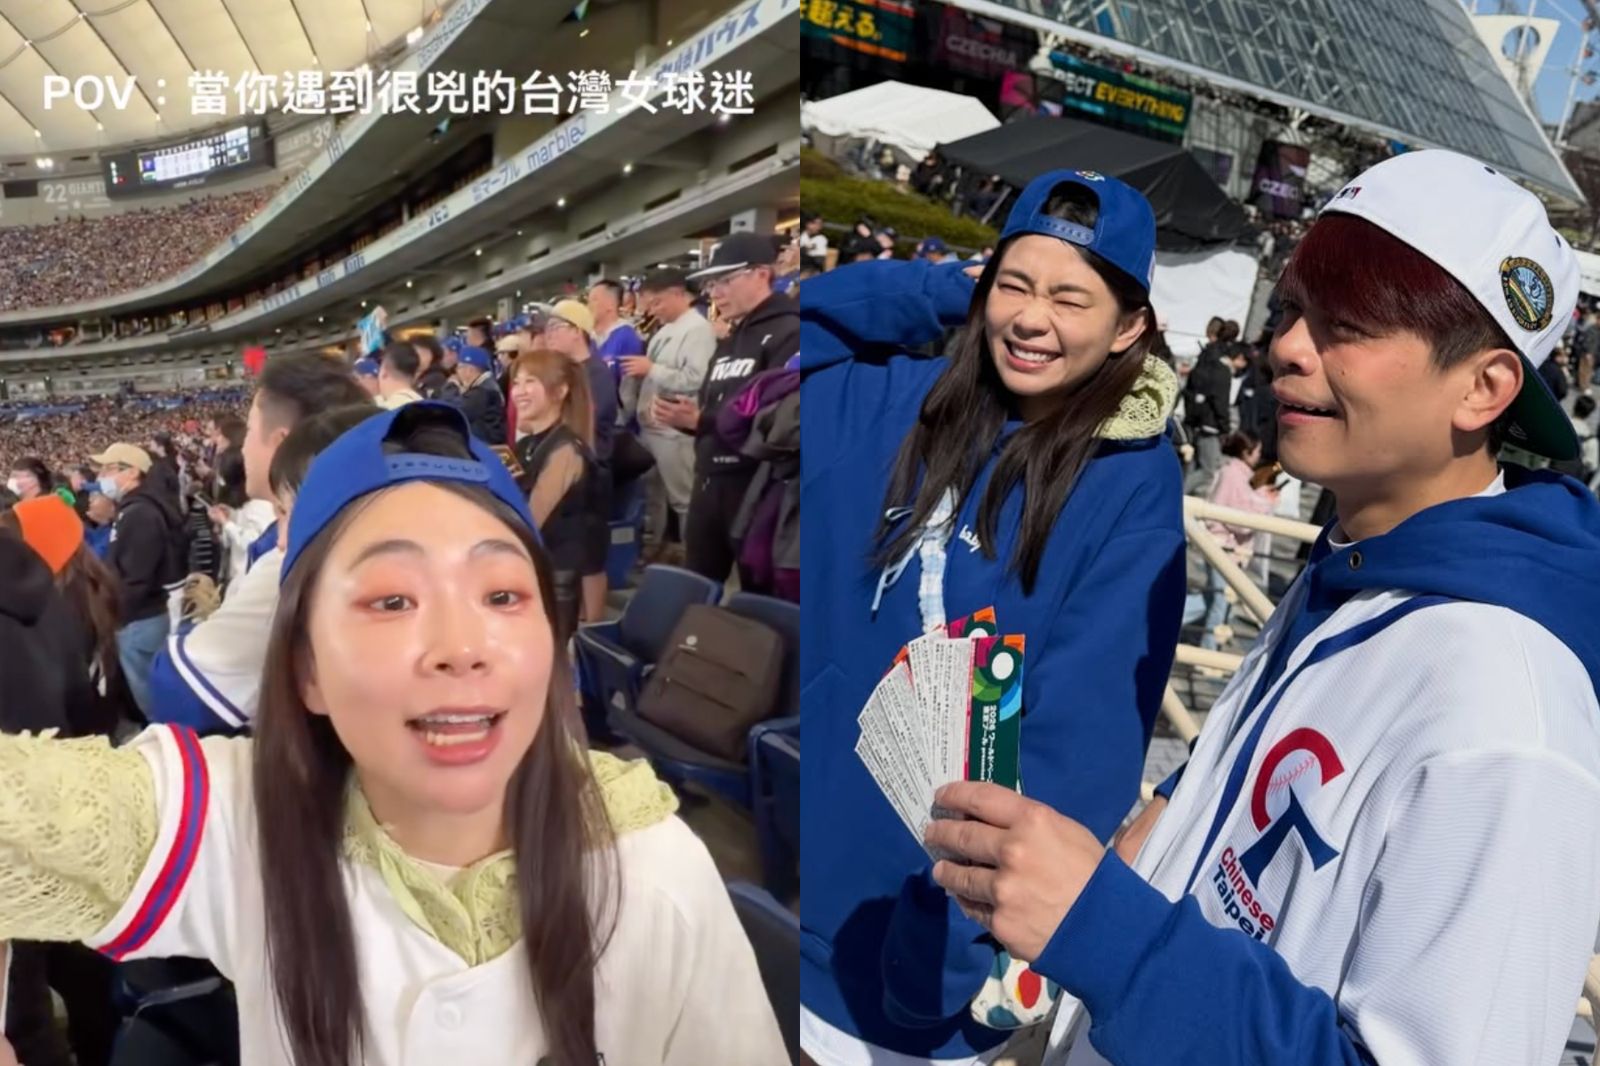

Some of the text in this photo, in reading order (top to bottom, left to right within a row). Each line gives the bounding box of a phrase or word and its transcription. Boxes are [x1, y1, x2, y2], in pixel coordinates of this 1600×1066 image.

[1095, 80, 1186, 123] EVERYTHING
[43, 182, 68, 203] 22
[1220, 846, 1275, 931] Chinese
